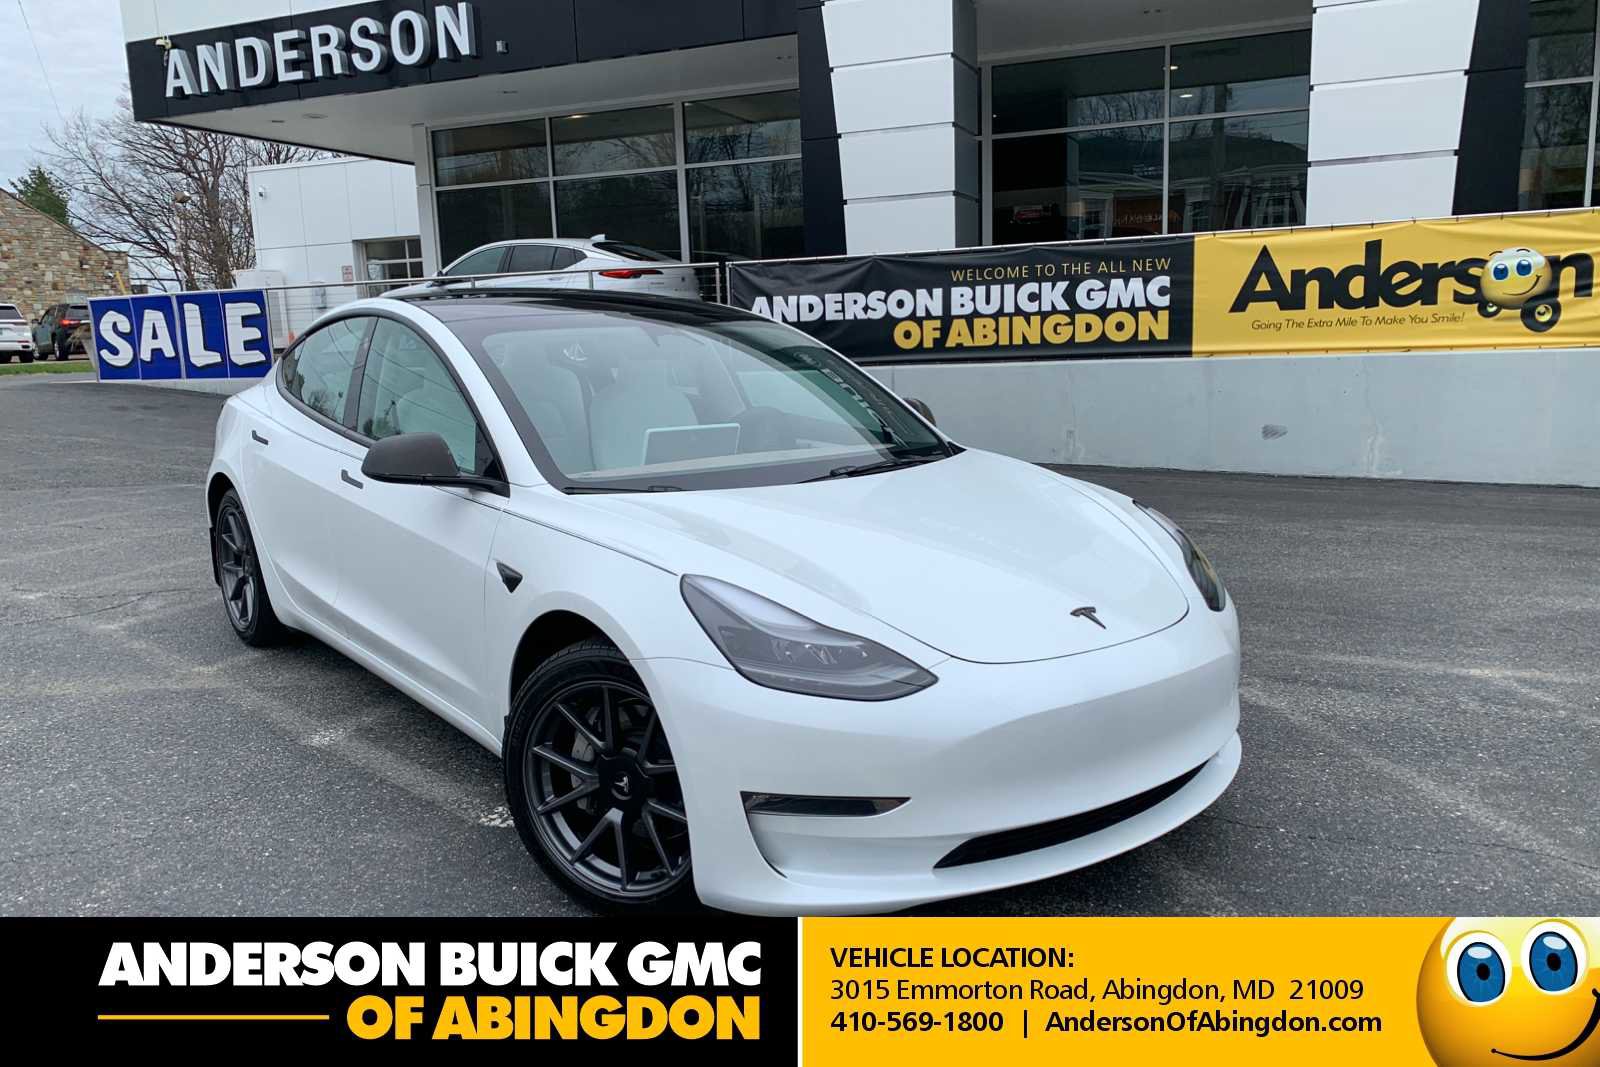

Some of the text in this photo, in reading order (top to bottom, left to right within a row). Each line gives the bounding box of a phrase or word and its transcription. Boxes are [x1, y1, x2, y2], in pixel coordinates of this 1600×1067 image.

[165, 1, 477, 99] ANDERSON
[951, 257, 1171, 282] WELCOME TO THE ALL NEW
[751, 276, 1171, 323] ANDERSON BUICK GMC
[100, 302, 266, 367] SALE
[893, 310, 1169, 350] OF ABINGDON
[1251, 312, 1466, 332] Going The Extra Mile To Make You Smile!
